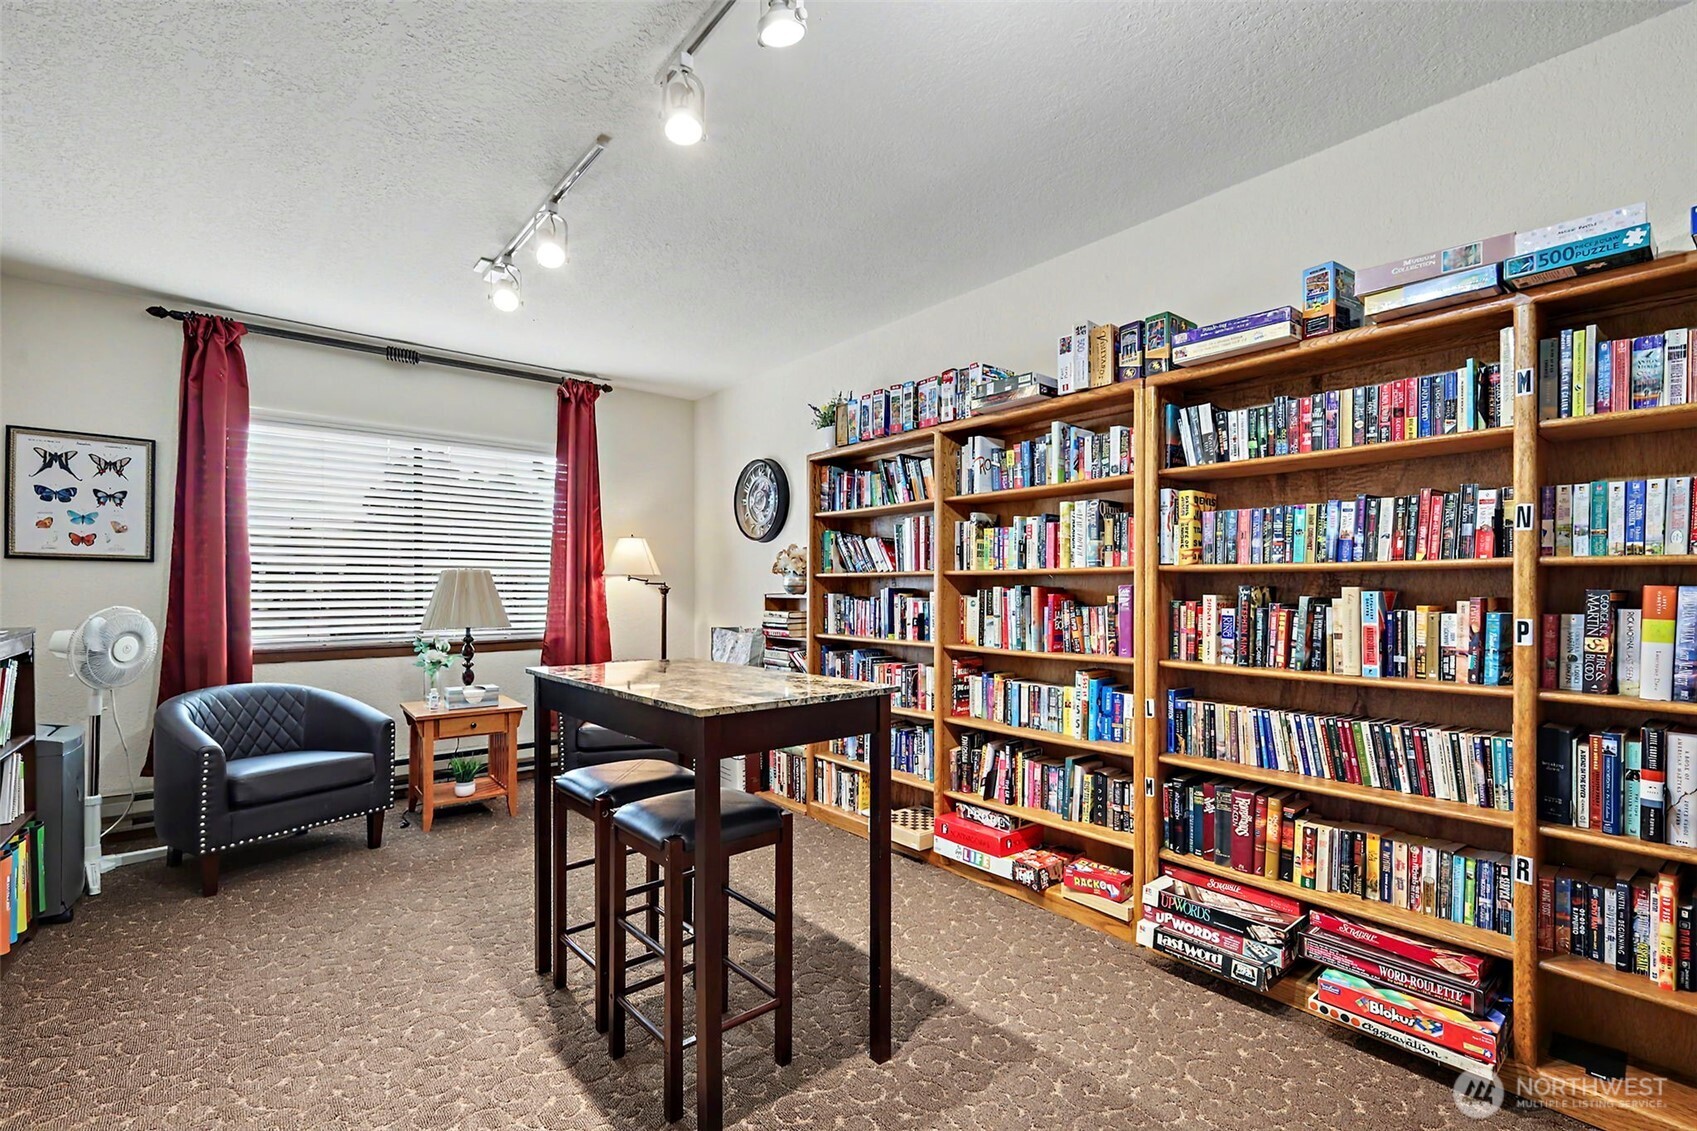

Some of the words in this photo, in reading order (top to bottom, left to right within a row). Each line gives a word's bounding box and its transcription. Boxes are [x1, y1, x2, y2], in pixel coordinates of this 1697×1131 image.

[1538, 245, 1575, 269] 500
[1575, 241, 1620, 259] PUZZLE
[1391, 260, 1437, 275] COLLECTION
[1518, 371, 1531, 393] M
[1517, 506, 1531, 528] N
[1240, 601, 1248, 635] STEPHEN
[1587, 593, 1600, 636] MARTIN
[1517, 621, 1530, 642] P
[1240, 637, 1248, 656] KING
[1584, 653, 1595, 681] BLOOD
[1596, 654, 1607, 670] FIRE
[1595, 671, 1606, 681] &
[1147, 701, 1153, 716] L
[962, 848, 991, 870] LIFE
[1517, 857, 1530, 881] R
[1206, 878, 1243, 894] SCRABBLE
[1160, 893, 1212, 922] UPWORDS
[1617, 891, 1626, 910] UNTIL
[1155, 912, 1221, 944] UPWORDS
[1338, 923, 1379, 944] SCRABBLE
[1617, 918, 1626, 955] BEGINNING
[1379, 965, 1465, 1002] WORD-ROULETTE
[1369, 1000, 1416, 1028] Blokus
